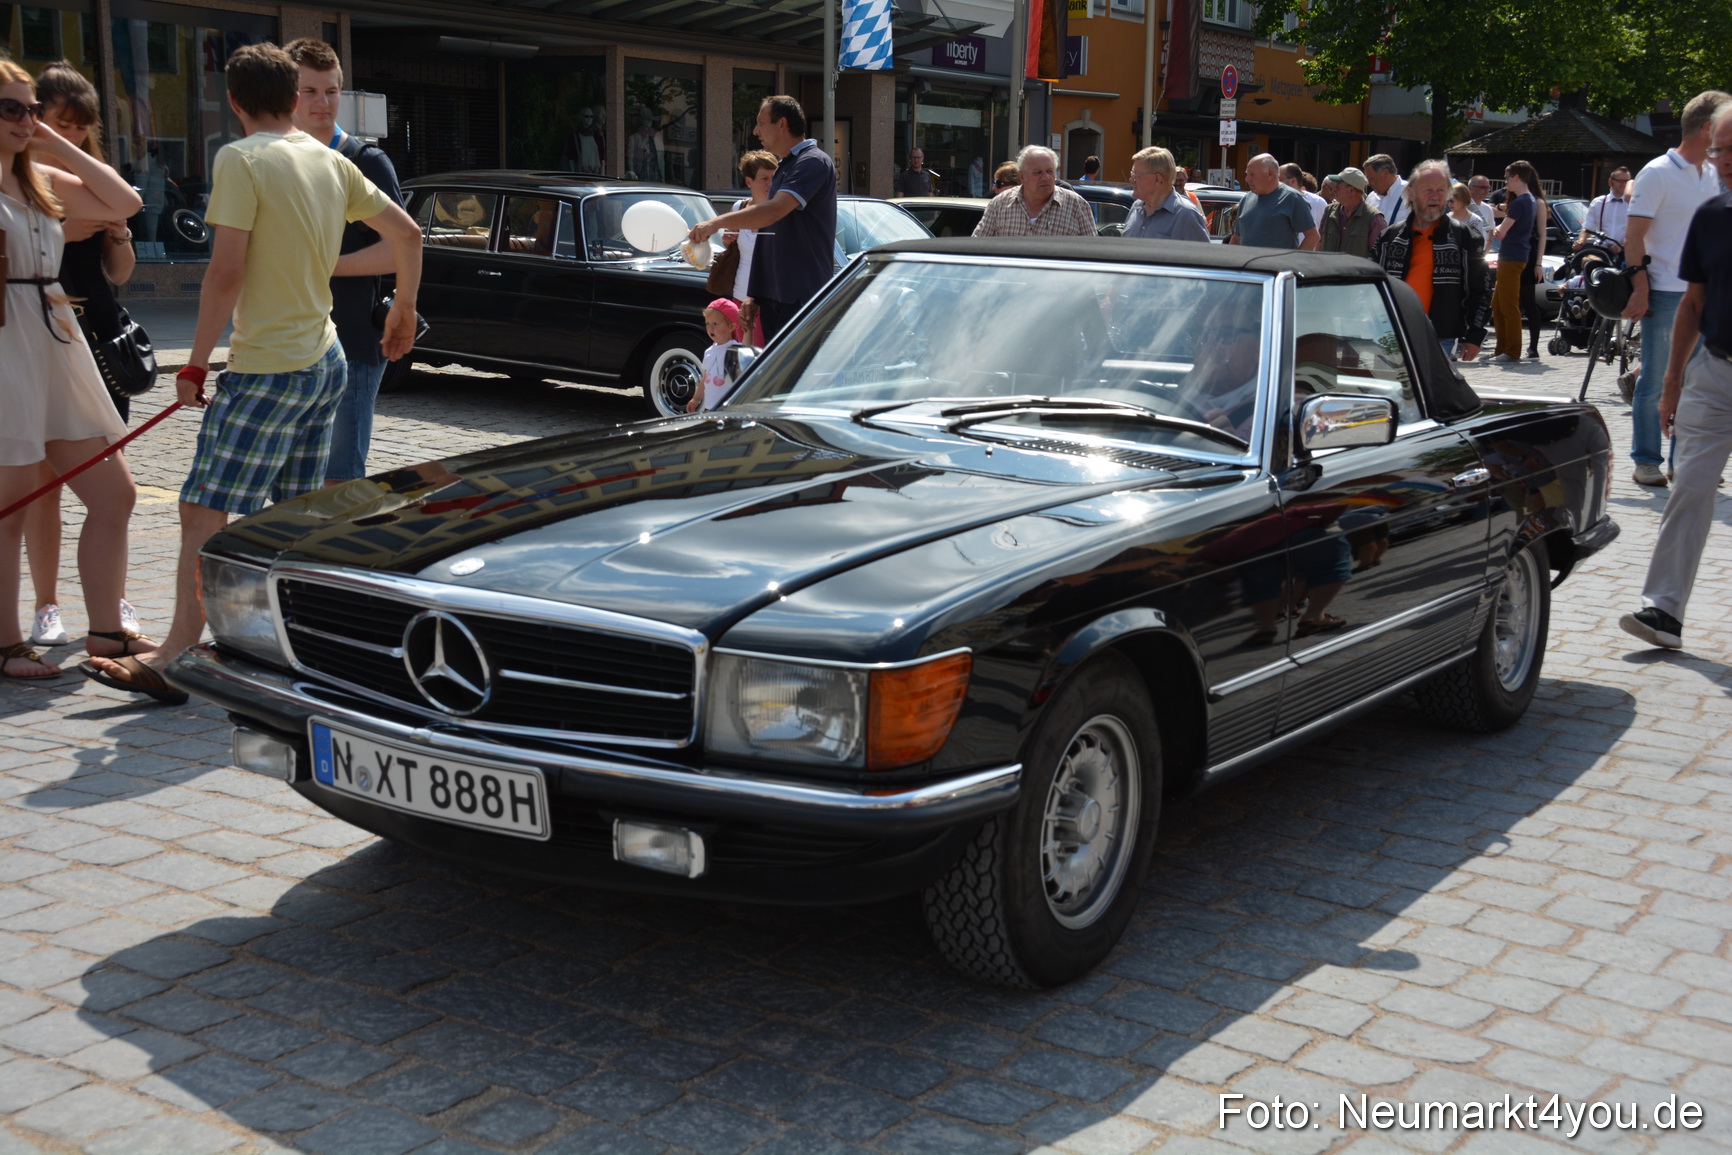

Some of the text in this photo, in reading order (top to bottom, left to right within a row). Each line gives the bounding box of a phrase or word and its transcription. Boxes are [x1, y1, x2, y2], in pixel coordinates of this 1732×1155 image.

[1069, 0, 1087, 11] ank
[947, 41, 978, 65] liberty
[321, 760, 329, 773] D
[333, 737, 537, 826] N XT 888H
